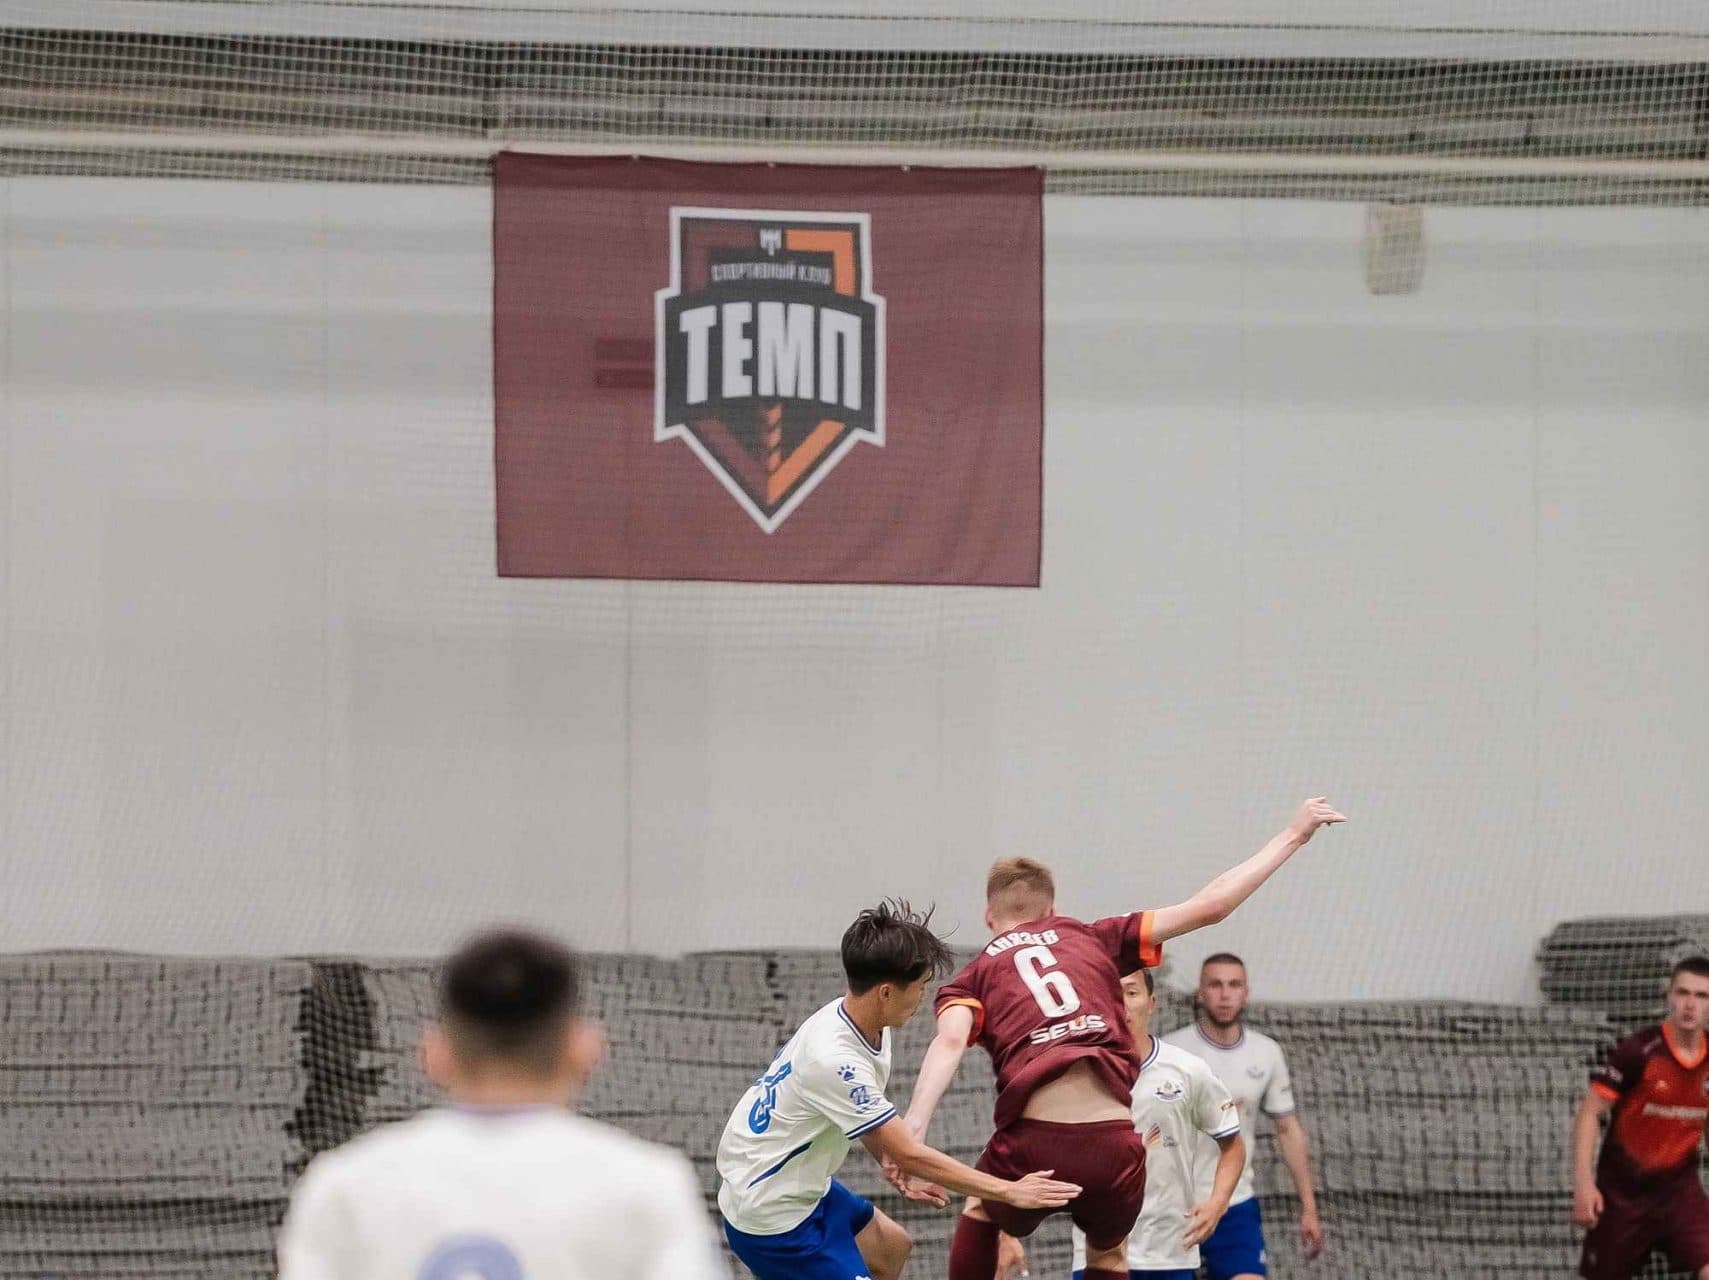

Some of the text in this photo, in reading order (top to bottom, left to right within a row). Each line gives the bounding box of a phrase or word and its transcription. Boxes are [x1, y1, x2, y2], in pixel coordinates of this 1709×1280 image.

[679, 301, 862, 411] ТЕМП
[1013, 945, 1081, 1018] 6
[1030, 1014, 1106, 1045] SEUS
